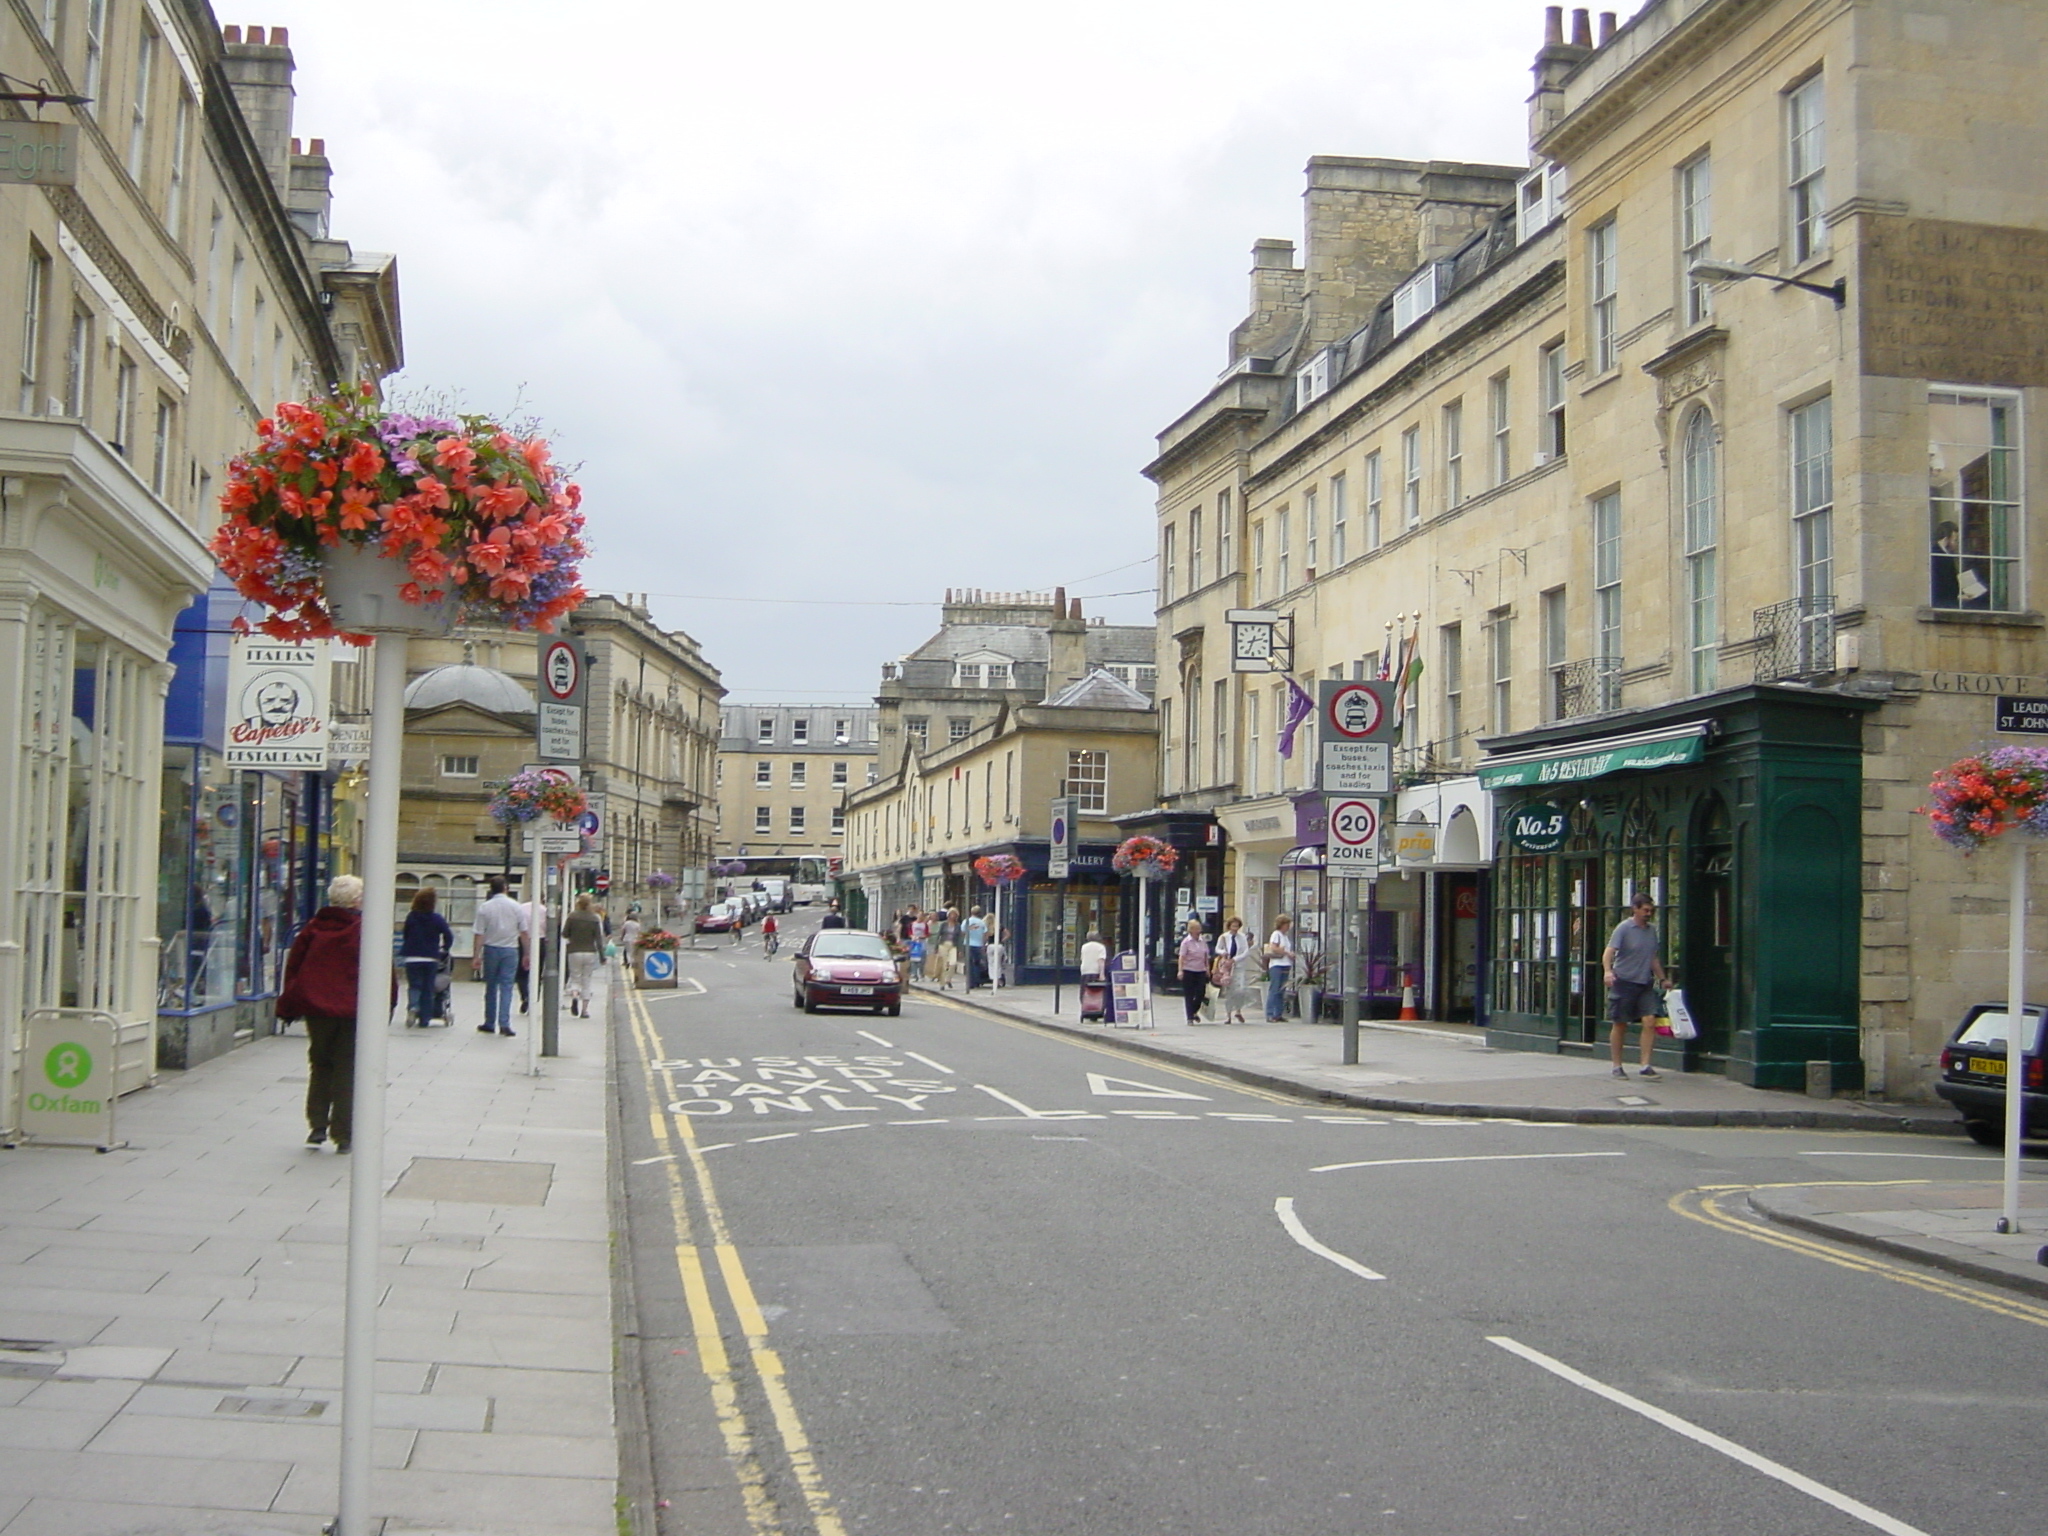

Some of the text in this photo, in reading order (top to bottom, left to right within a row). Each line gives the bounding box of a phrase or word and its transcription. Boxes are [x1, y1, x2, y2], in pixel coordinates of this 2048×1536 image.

[247, 650, 315, 661] ITALIAN
[1933, 671, 2029, 694] GROVE
[2001, 716, 2017, 728] ST.
[328, 742, 370, 753] SURGER
[1333, 745, 1363, 753] Except
[227, 751, 321, 762] RESTAURANT
[1340, 814, 1369, 832] 20
[1515, 815, 1562, 836] No.5
[1332, 847, 1373, 859] ZONE
[651, 1056, 904, 1070] BUSES
[692, 1066, 895, 1082] AND
[676, 1078, 957, 1098] TAXIS
[27, 1092, 102, 1114] Oxfam
[667, 1094, 929, 1115] ONLY
